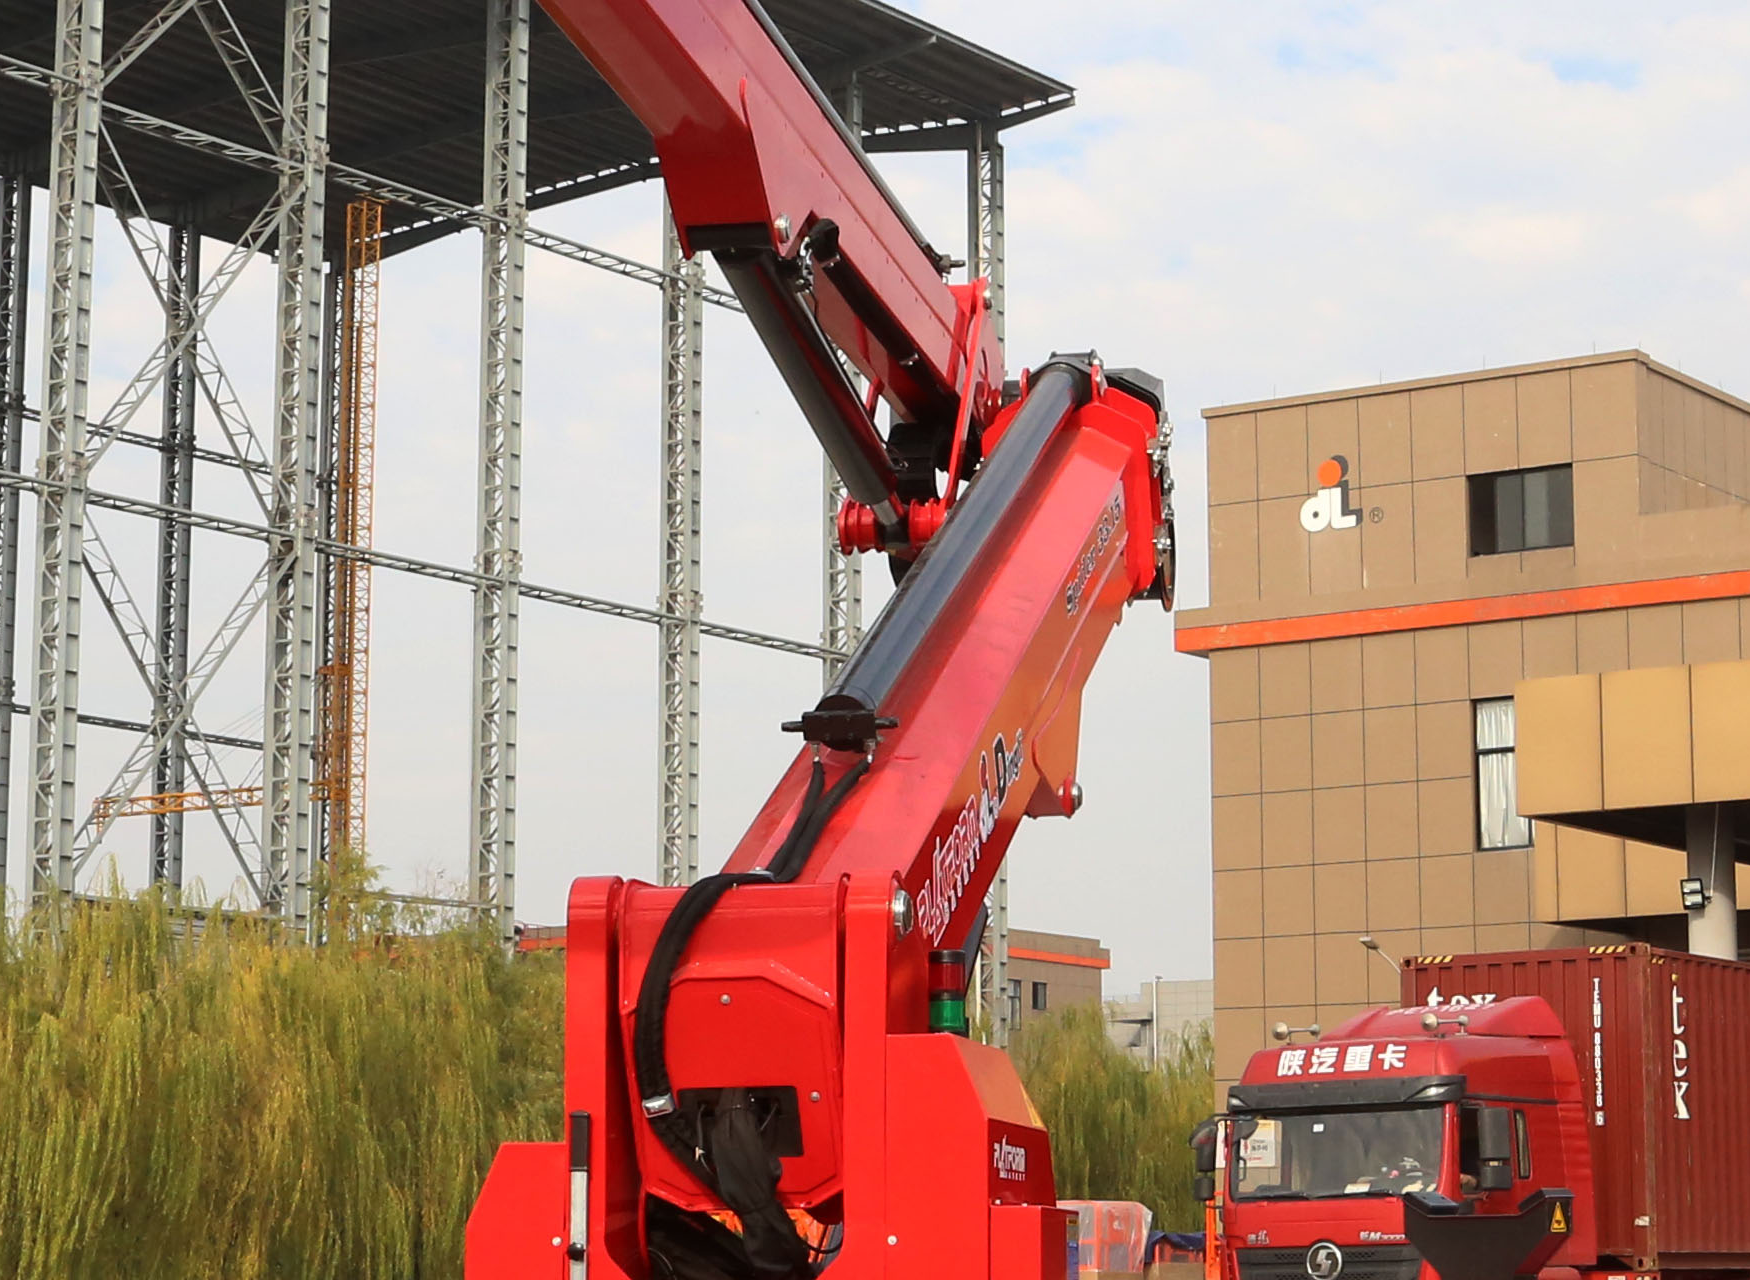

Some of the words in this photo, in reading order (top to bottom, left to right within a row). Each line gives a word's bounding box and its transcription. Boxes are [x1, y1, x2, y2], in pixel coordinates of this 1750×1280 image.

[1592, 977, 1602, 1028] TEMU
[1276, 1043, 1408, 1077] 陕汽重卡
[1672, 985, 1691, 1119] tex
[1595, 1111, 1604, 1125] 6
